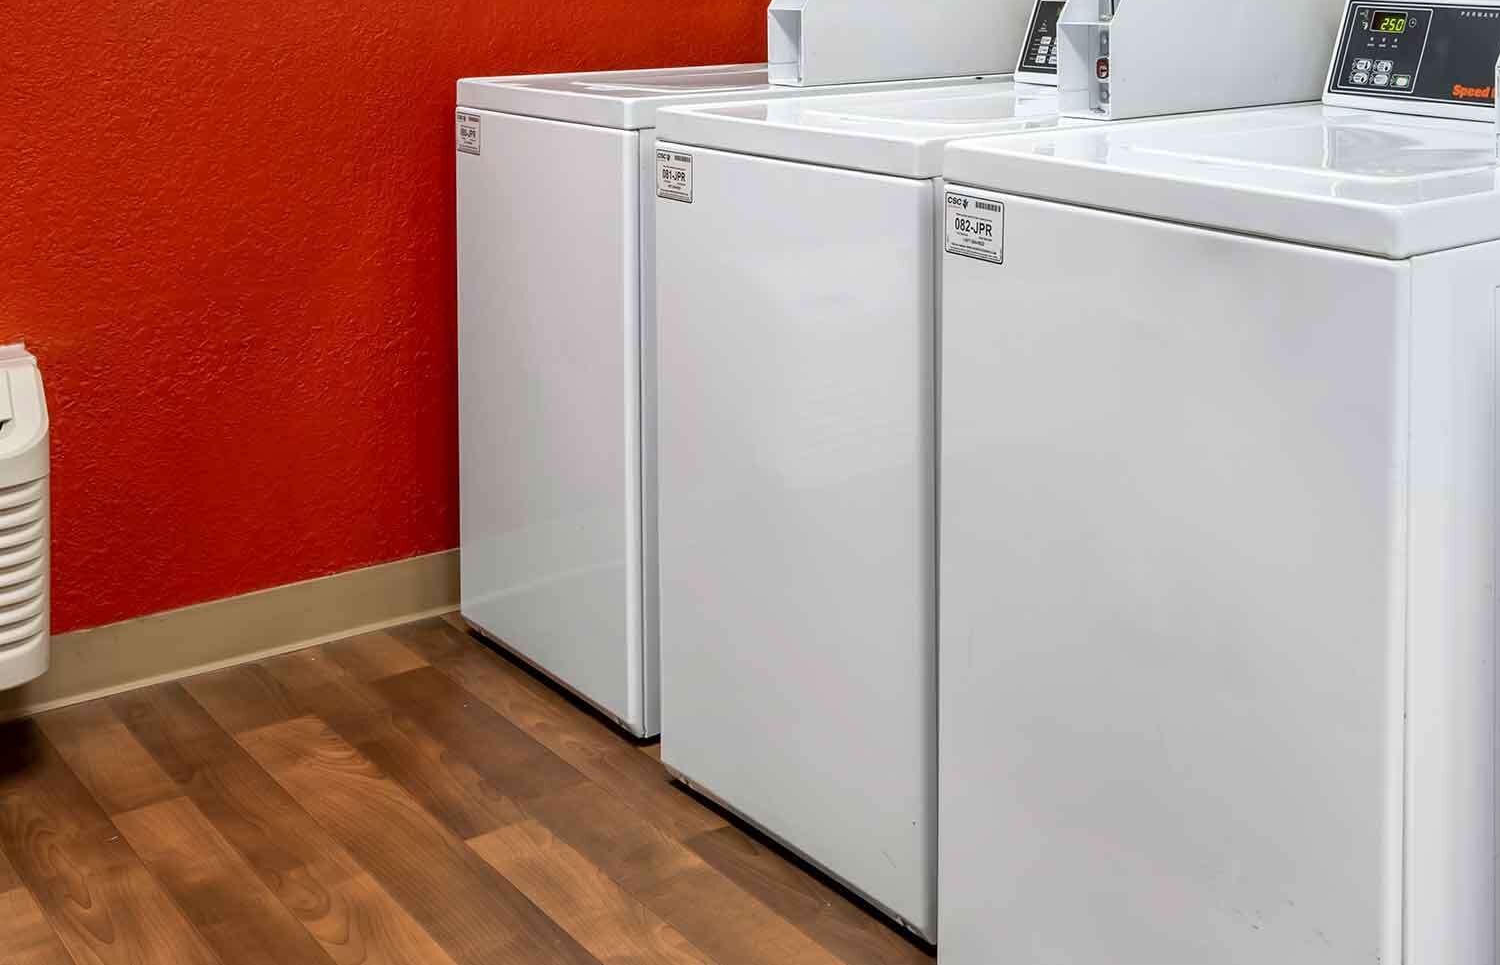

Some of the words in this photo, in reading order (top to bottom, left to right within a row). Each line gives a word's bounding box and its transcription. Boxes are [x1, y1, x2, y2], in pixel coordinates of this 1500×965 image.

[1452, 84, 1490, 98] Speed
[947, 196, 962, 206] CSC
[954, 217, 993, 237] 082-JPR
